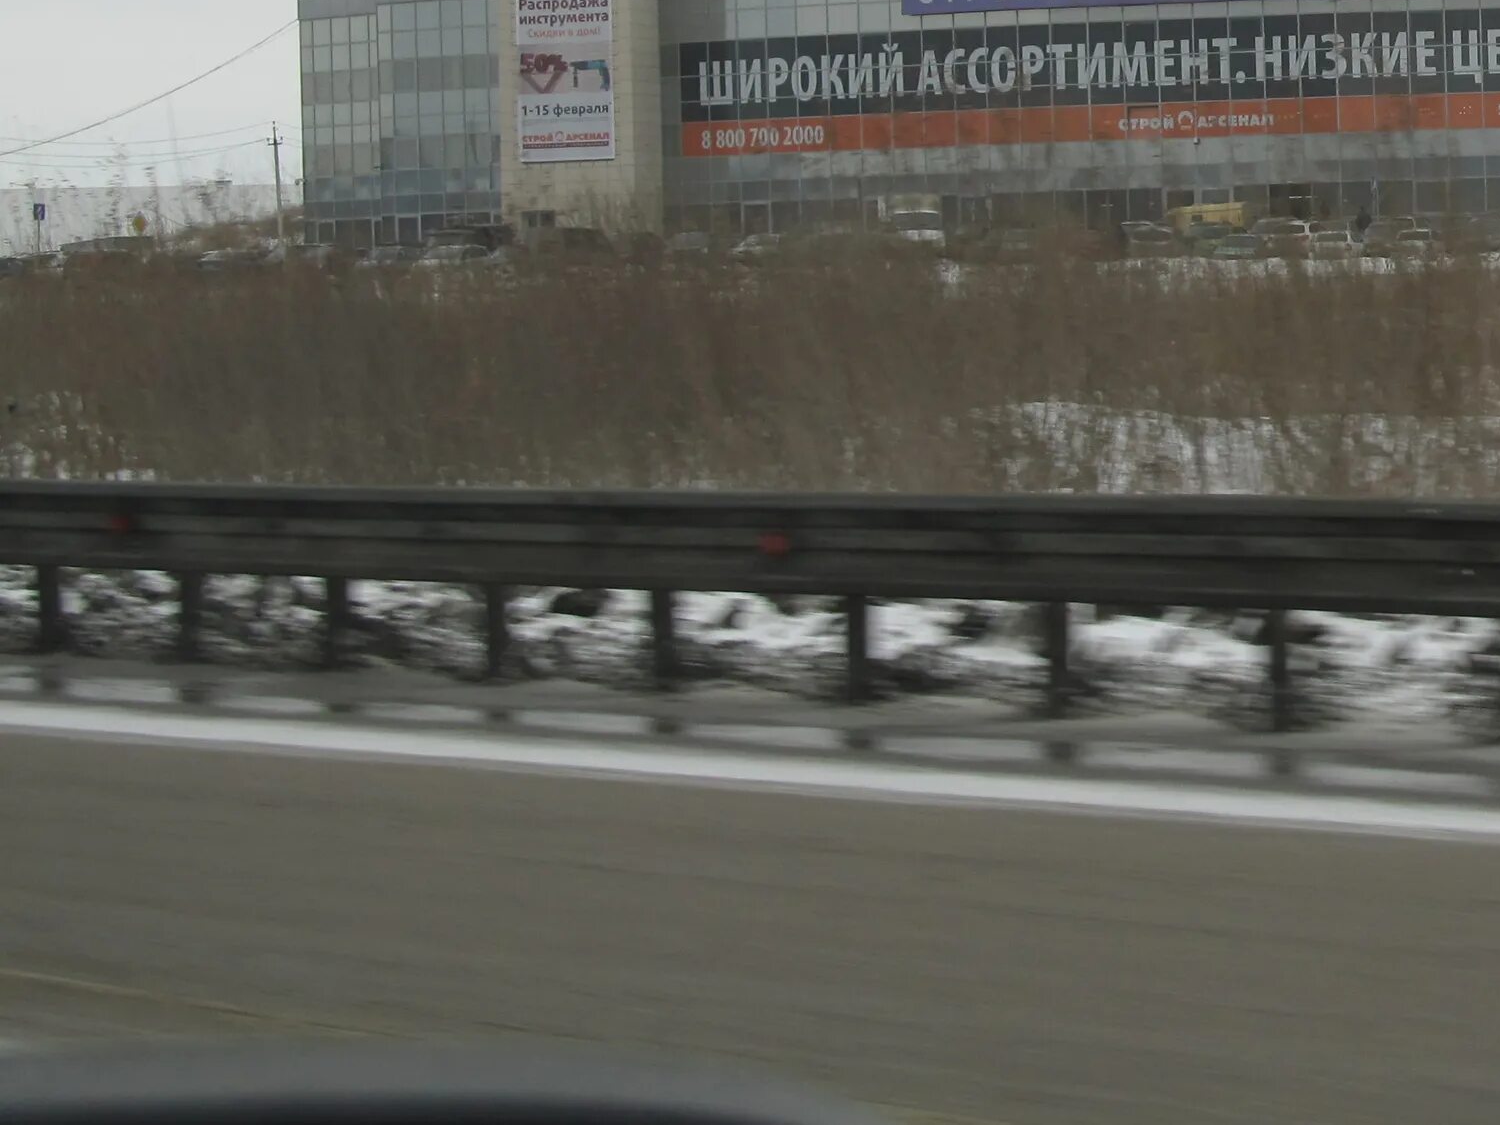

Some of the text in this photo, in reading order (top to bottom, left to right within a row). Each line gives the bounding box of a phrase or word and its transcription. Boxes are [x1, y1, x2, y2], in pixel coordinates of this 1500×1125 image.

[519, 12, 609, 27] инструмента
[700, 43, 904, 106] ШИРОКИЙ
[1254, 30, 1437, 82] НИЗКИЕ
[522, 103, 609, 117] 1-15 февраля
[1118, 114, 1275, 131] СТРОЙ АРСЕНАЛ
[702, 125, 824, 149] 8 800 700 2000
